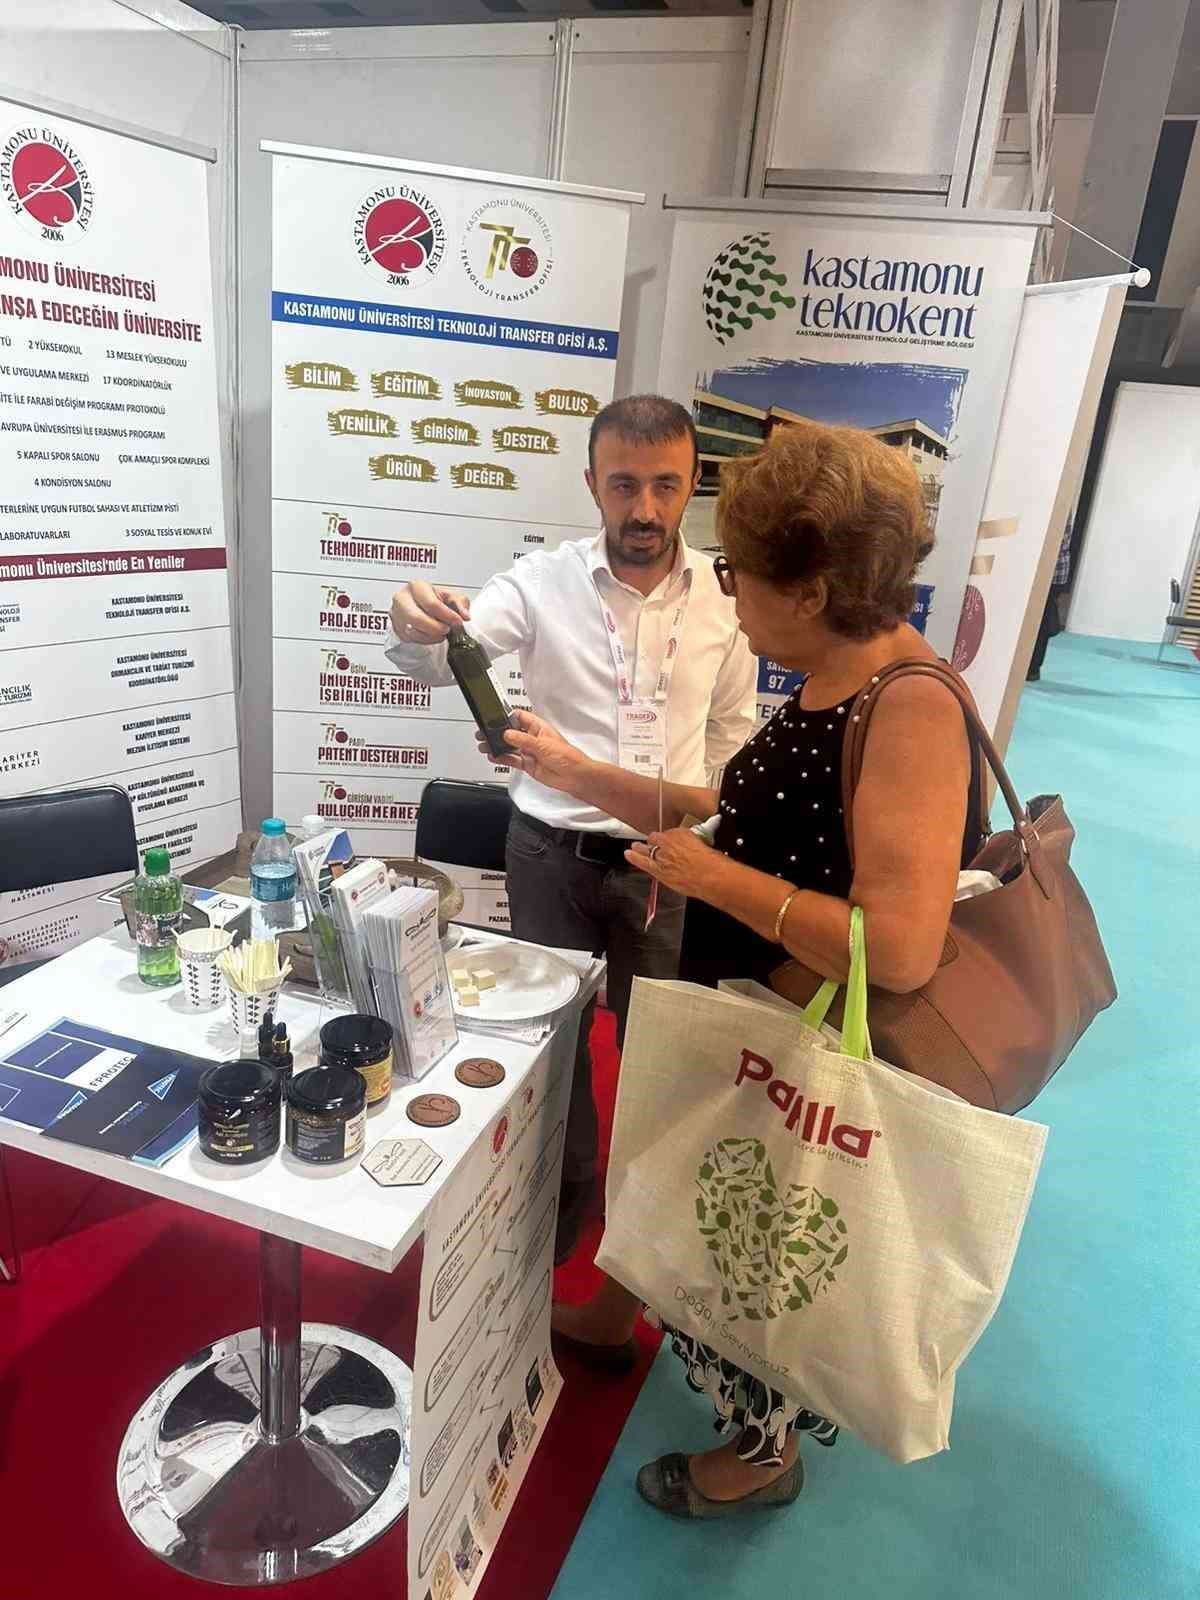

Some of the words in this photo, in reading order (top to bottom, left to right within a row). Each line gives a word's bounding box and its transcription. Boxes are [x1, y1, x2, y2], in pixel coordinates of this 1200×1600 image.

[1, 127, 38, 215] KASTAMONU
[465, 199, 508, 232] KASTAMONU
[41, 226, 64, 242] 2006
[354, 186, 395, 265] KASTAMONU
[400, 185, 447, 275] ÜNİVERSİTESİ
[0, 255, 49, 284] MONU
[54, 261, 157, 303] ÜNİVERSİTESİ
[386, 273, 410, 286] 2006
[460, 249, 493, 297] TEKNOLOJİ
[495, 284, 540, 301] TRANSFER
[802, 248, 984, 297] kastamonu
[0, 294, 38, 320] NŞA
[41, 299, 120, 331] EDECEĞİN
[123, 308, 202, 342] ÜNİVERSİTE
[799, 292, 978, 340] teknokent
[283, 300, 356, 322] KASTAMONU
[358, 306, 435, 331] ÜNİVERSİTESİ
[437, 317, 497, 338] TEKNOLOJİ
[499, 325, 555, 345] TRANSFER
[557, 331, 585, 349] OFİSİ
[587, 336, 609, 353] A.Ş.
[795, 330, 832, 338] KASTAMONU
[28, 340, 34, 350] 2
[34, 339, 83, 355] YÜKSEKOKUL
[106, 349, 115, 359] 13
[116, 351, 143, 362] MESLEK
[12, 366, 58, 380] UYGULAMA
[58, 370, 90, 382] MERKEZİ
[103, 375, 111, 385] 17
[302, 365, 342, 387] BİLİM
[384, 374, 430, 396] EĞİTİM
[464, 384, 513, 402] İNOVASYON
[14, 392, 25, 404] İLE
[26, 395, 54, 407] FARABİ
[55, 396, 86, 410] DEĞİŞİM
[87, 400, 125, 412] PROGRAMI
[547, 391, 590, 413] BULUŞ
[1, 421, 32, 432] AVRUPA
[33, 421, 83, 435] ÜNİVERSİTESİ
[94, 427, 128, 438] ERASMUS
[128, 429, 166, 440] PROGRAMI
[336, 413, 389, 434] YENİLİK
[423, 421, 469, 443] GİRİŞİM
[502, 430, 550, 451] DESTEK
[16, 450, 22, 460] 5
[23, 450, 50, 461] KAPALI
[51, 451, 71, 461] SPOR
[71, 452, 100, 462] SALONU
[118, 454, 134, 464] ÇOK
[161, 455, 177, 465] SPOR
[385, 458, 423, 479] ÜRÜN
[463, 466, 505, 487] DEĞER
[34, 478, 40, 487] 4
[40, 476, 84, 488] KONDİSYON
[84, 478, 112, 488] SALONU
[40, 504, 68, 514] UYGUN
[69, 504, 96, 513] FUTBOL
[96, 504, 120, 513] SAHASI
[120, 504, 130, 513] VE
[125, 528, 130, 537] 3
[130, 528, 156, 537] SOSYAL
[156, 526, 174, 537] TESİS
[174, 528, 182, 536] VE
[0, 564, 34, 578] monu
[130, 556, 145, 570] En
[147, 554, 185, 570] Yeniler
[319, 612, 358, 628] PROJE
[360, 614, 389, 631] DEST
[767, 674, 786, 690] 97
[381, 691, 432, 707] MERKEZİ
[317, 746, 359, 762] PATENT
[360, 748, 400, 763] DESTEK
[401, 748, 428, 764] OFİSİ
[372, 806, 422, 820] MERKEZ
